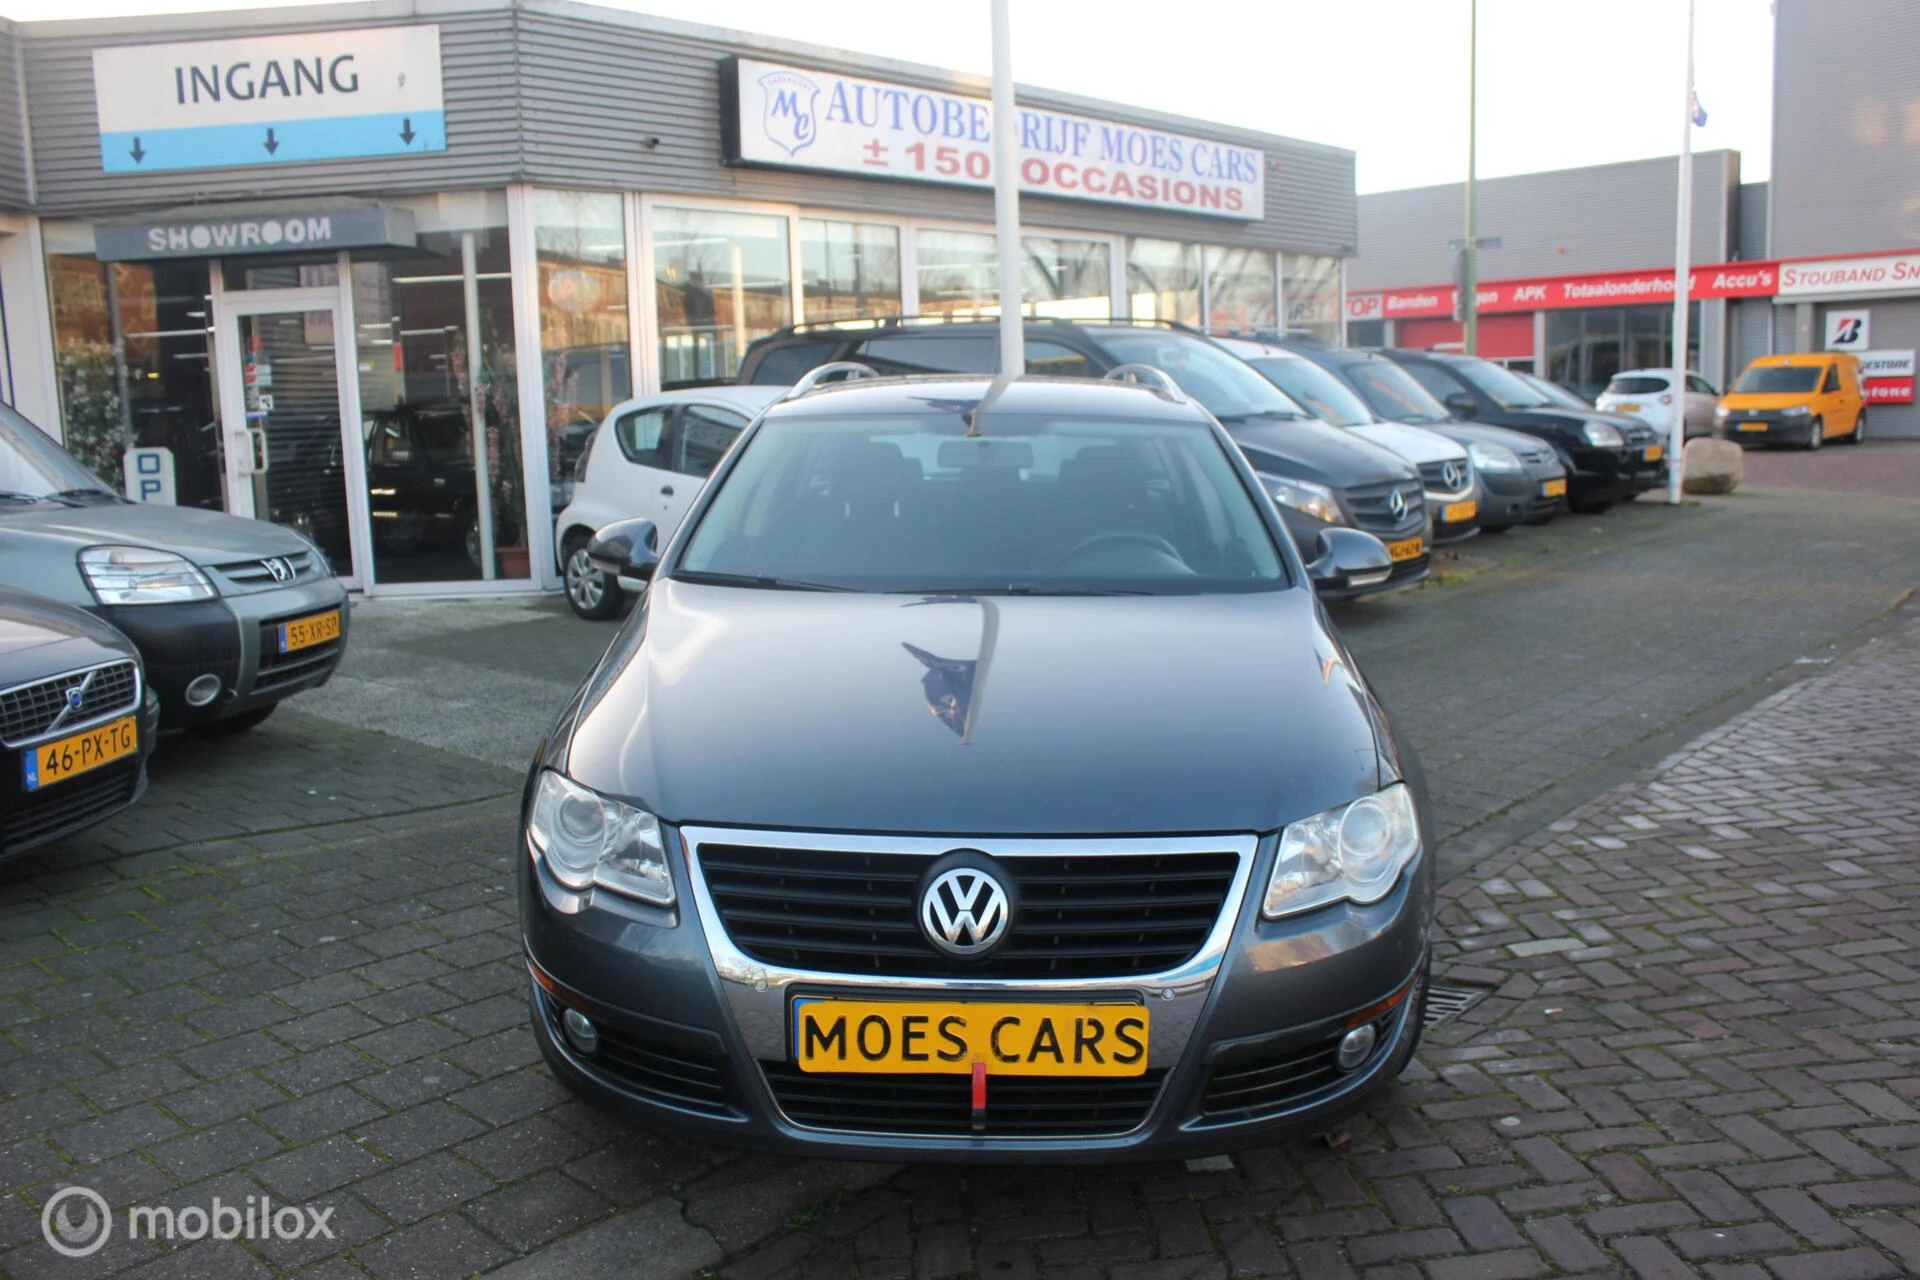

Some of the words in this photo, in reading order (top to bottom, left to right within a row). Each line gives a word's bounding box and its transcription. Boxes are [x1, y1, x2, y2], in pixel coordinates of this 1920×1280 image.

[175, 54, 359, 105] INGANG
[825, 80, 1091, 157] AUTOBERIJF
[1100, 126, 1183, 173] MOES
[1190, 142, 1258, 184] CARS
[904, 141, 991, 180] 150
[1021, 157, 1244, 212] OCCASIONS
[147, 216, 332, 252] SHOWROOM
[1387, 294, 1438, 311] Banden
[1513, 285, 1547, 303] APK
[1563, 275, 1697, 300] Totaalonderhod
[1712, 270, 1773, 290] Accu's
[1783, 267, 1886, 288] STOUBAND
[45, 723, 131, 776] 46-PX-TG
[804, 1014, 968, 1062] MOES
[990, 1016, 1145, 1065] CARS
